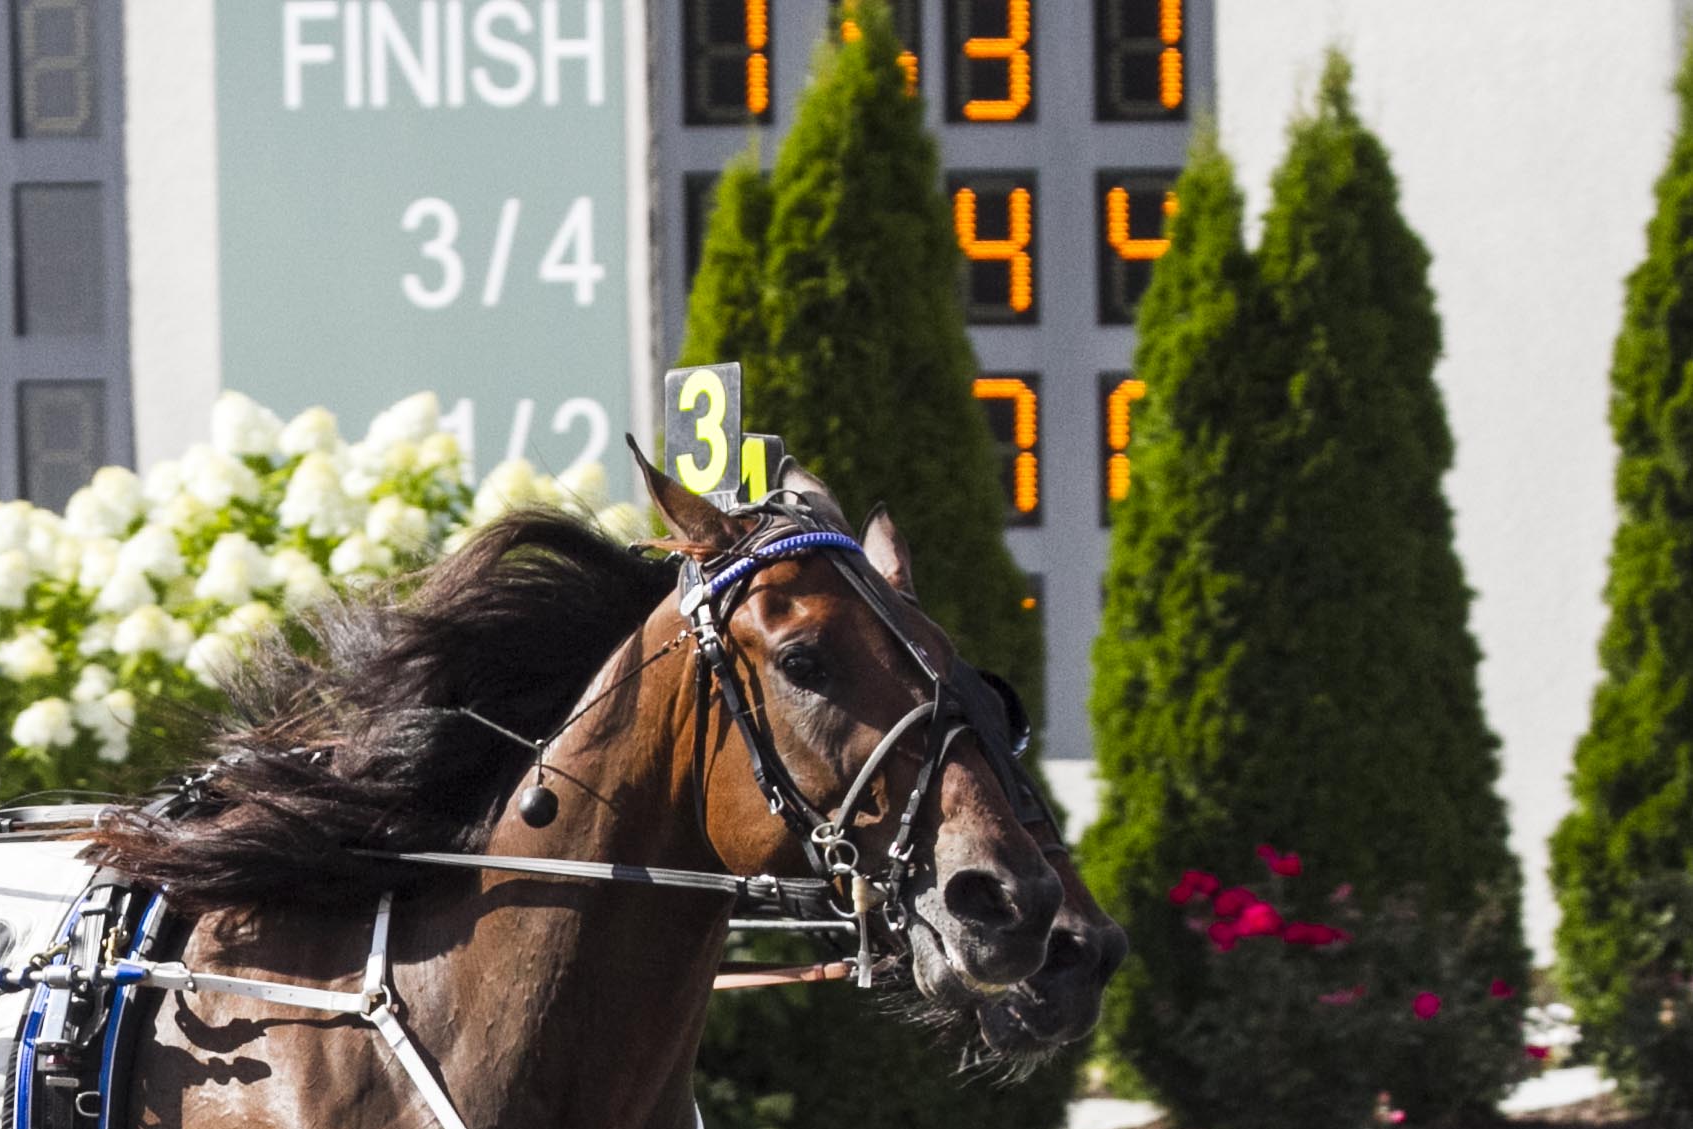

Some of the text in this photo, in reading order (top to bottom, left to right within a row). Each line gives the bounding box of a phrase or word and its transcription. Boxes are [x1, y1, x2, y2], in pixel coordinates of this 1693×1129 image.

[283, 0, 605, 109] FINISH
[401, 196, 606, 309] 3/4
[955, 187, 1032, 312] 4
[676, 369, 728, 495] 3
[742, 437, 767, 503] 1
